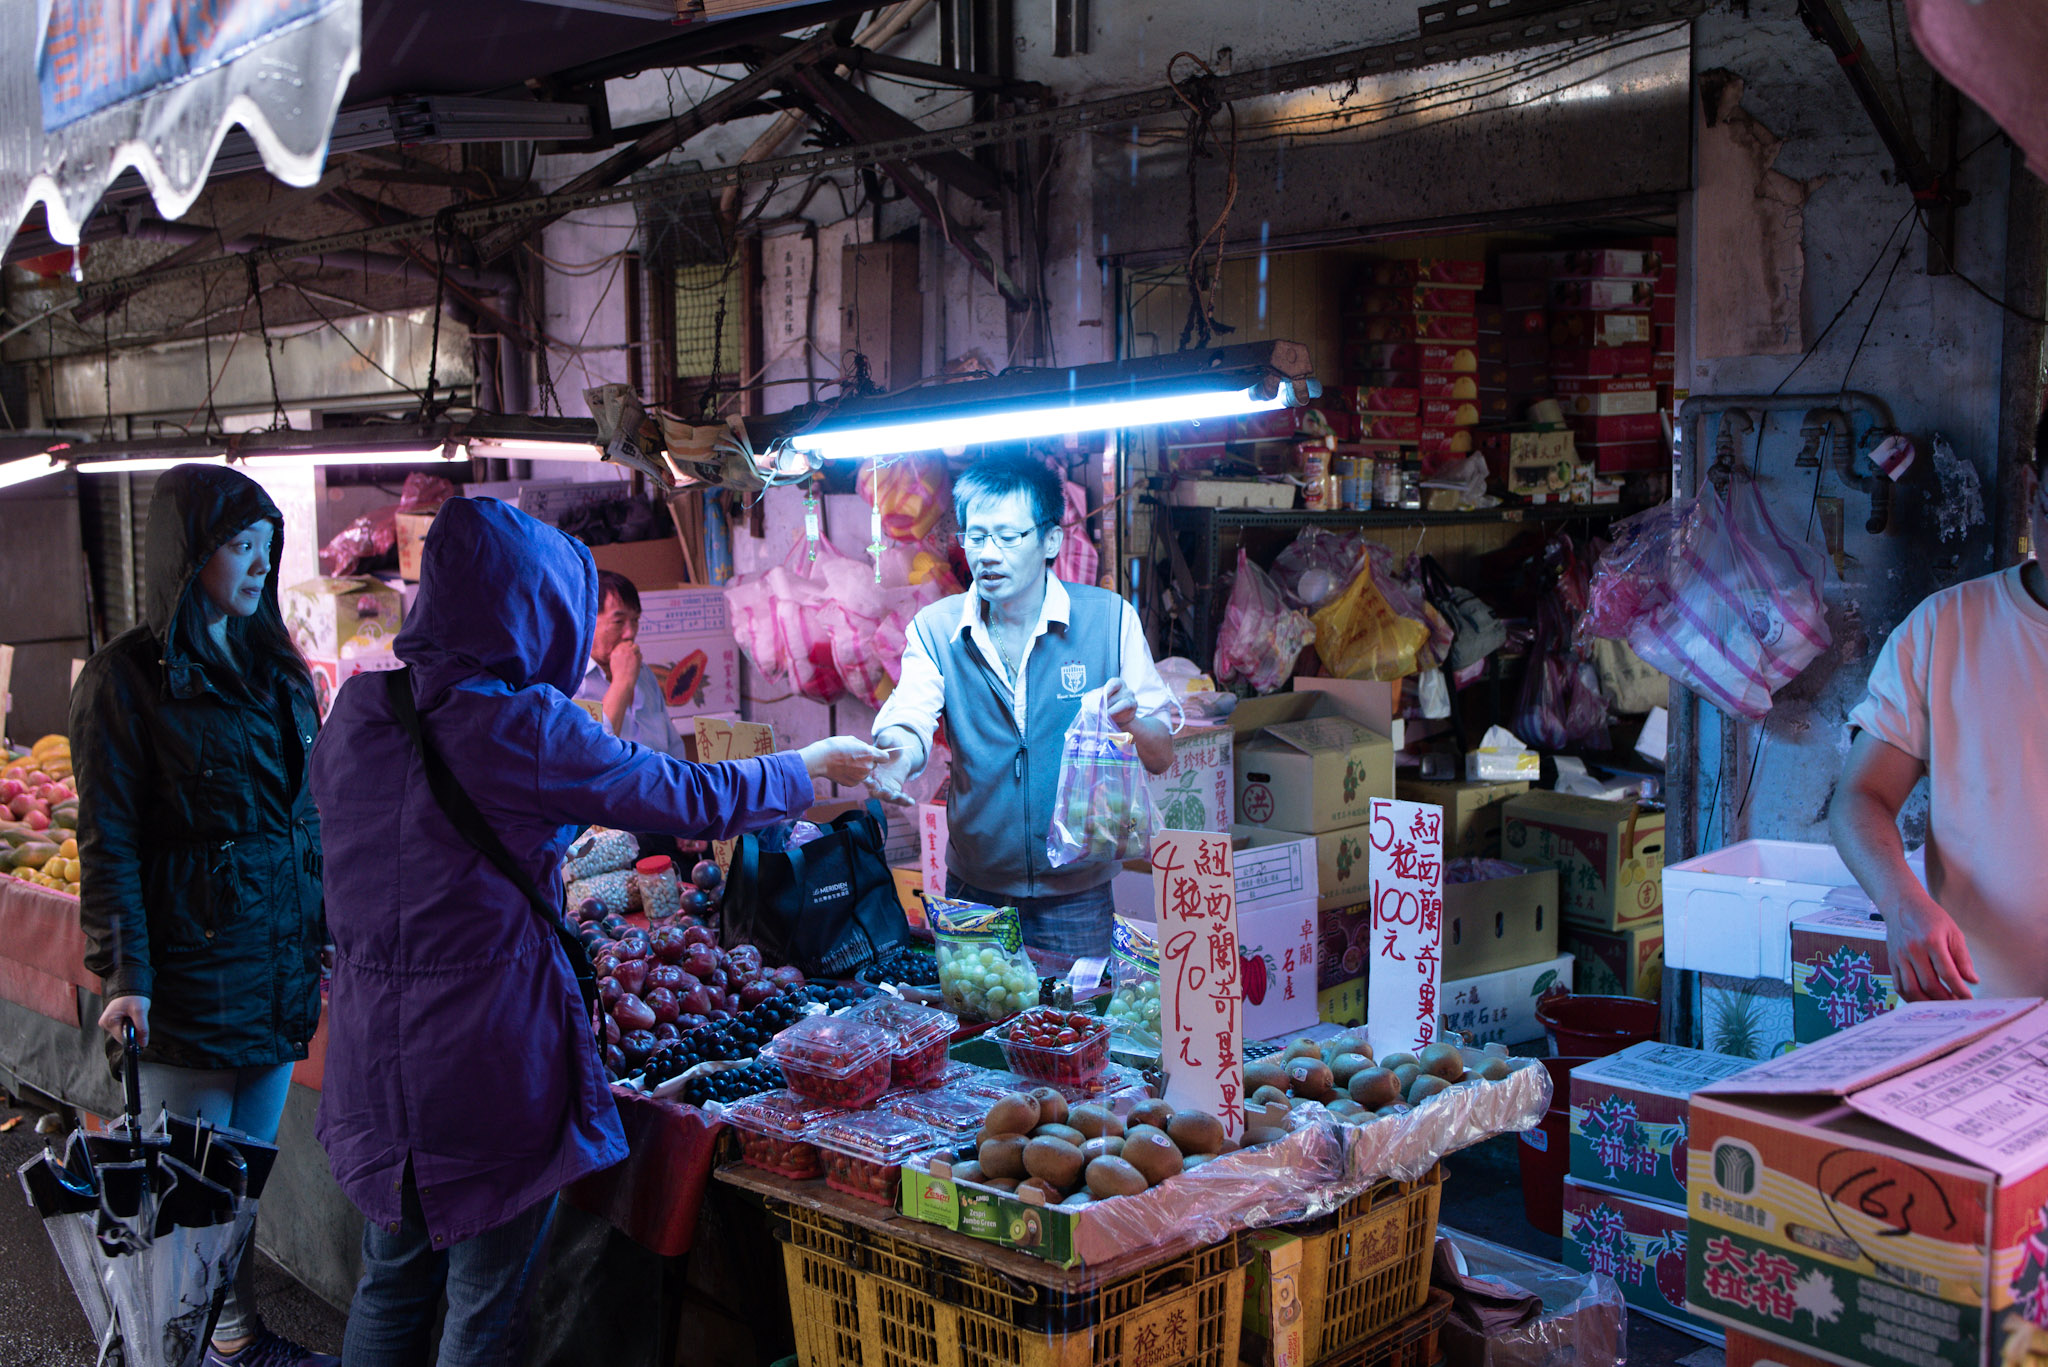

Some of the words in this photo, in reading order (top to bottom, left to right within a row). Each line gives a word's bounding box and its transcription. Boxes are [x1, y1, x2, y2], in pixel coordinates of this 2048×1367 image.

[1215, 770, 1228, 833] 品質保
[820, 881, 848, 894] MERIDIEN
[1281, 947, 1296, 1002] 名產
[1804, 952, 1875, 996] 大坑
[1580, 1100, 1639, 1140] 大坑
[923, 1186, 951, 1203] Zespri
[969, 1208, 986, 1218] Zespri
[962, 1216, 981, 1226] Jumbo
[980, 1218, 997, 1229] Green
[1572, 1205, 1626, 1249] 大坑
[1703, 1235, 1799, 1293] 大坑
